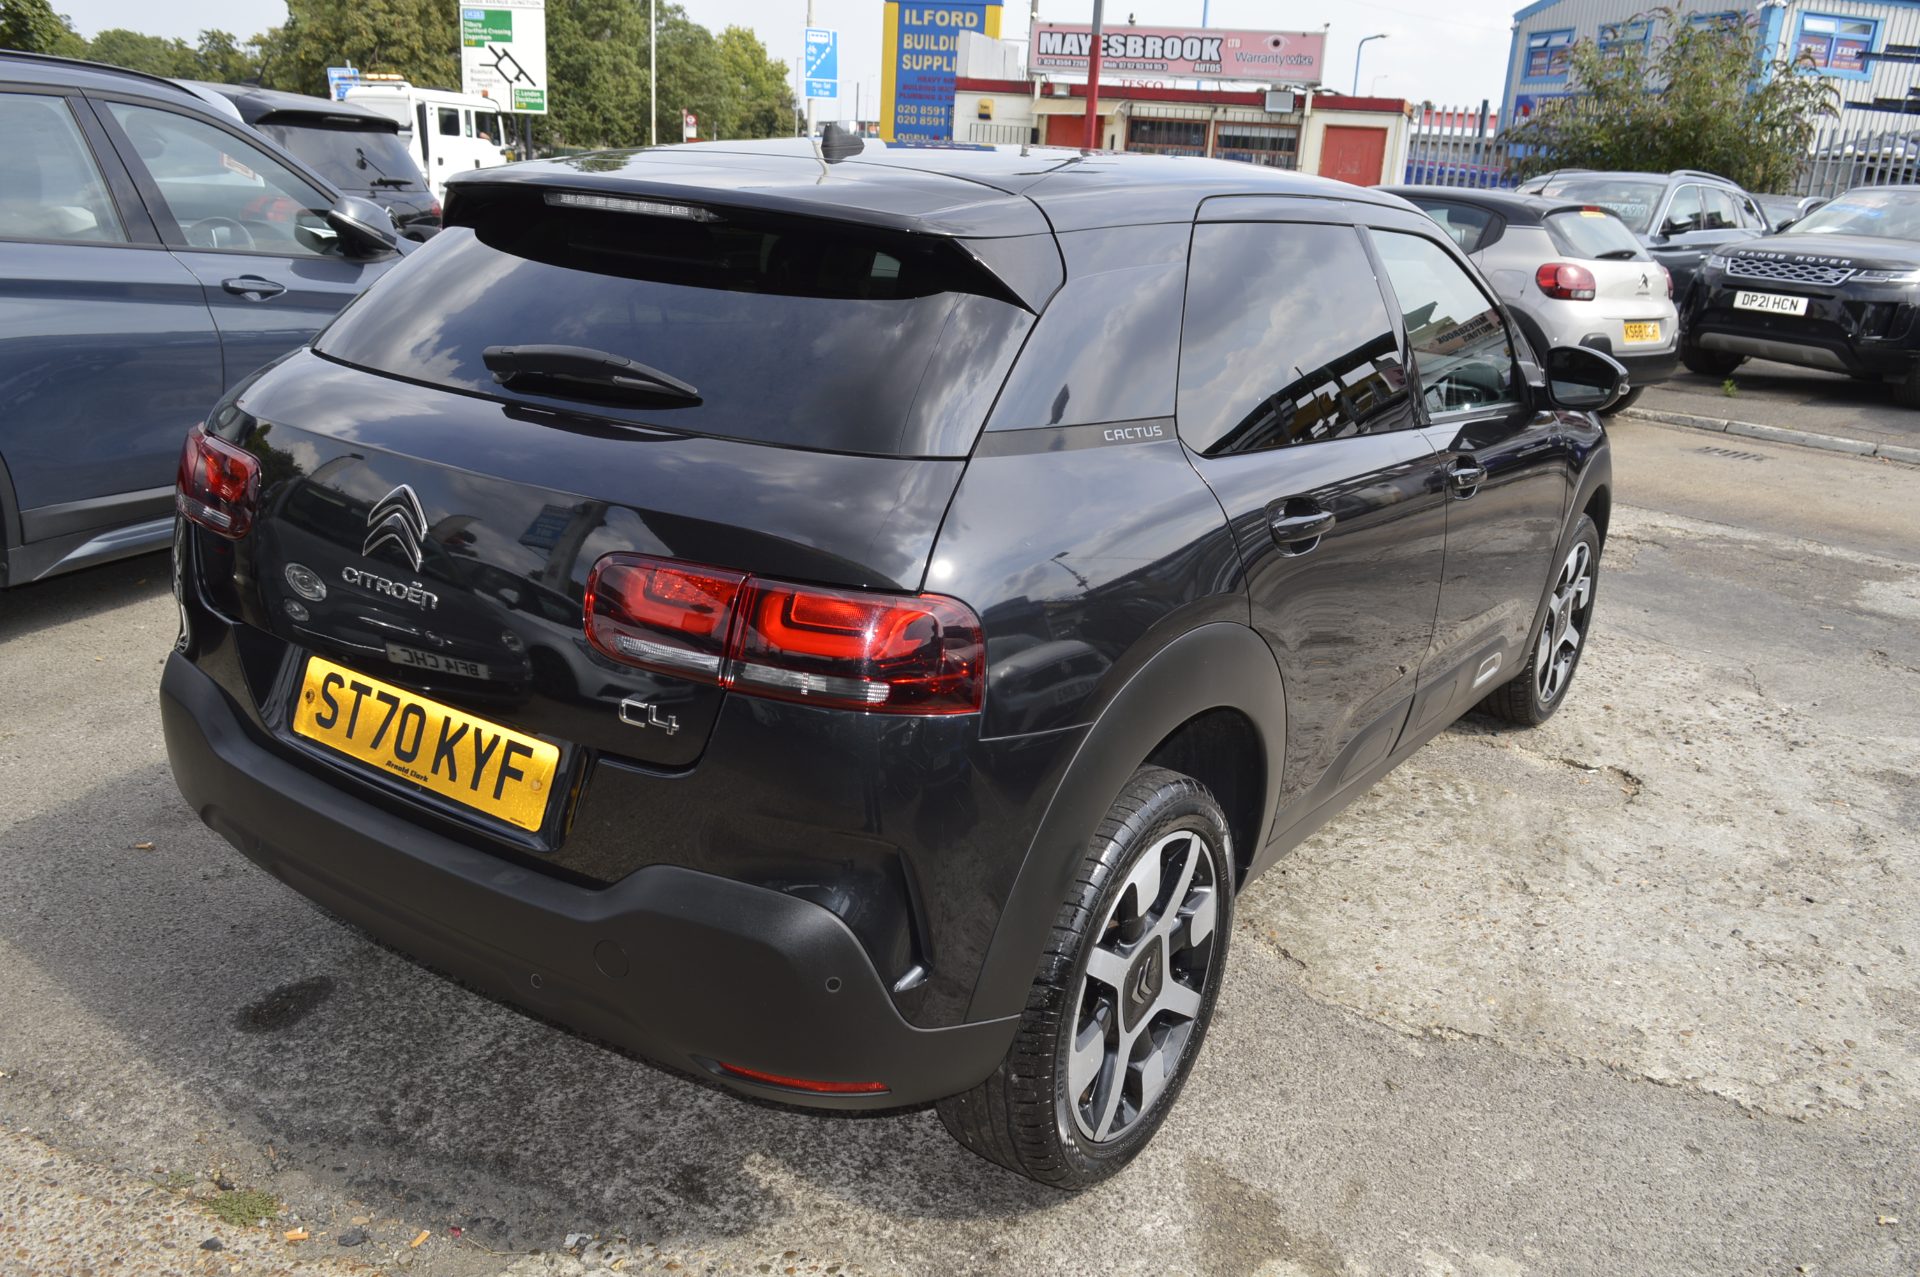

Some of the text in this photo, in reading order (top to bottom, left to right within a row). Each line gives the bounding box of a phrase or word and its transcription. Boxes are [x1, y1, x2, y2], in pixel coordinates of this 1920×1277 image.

[904, 9, 979, 28] ILFORD
[1038, 31, 1223, 62] MAYESBROOK
[1193, 62, 1222, 73] AUTOS
[1120, 79, 1164, 89] TESCO
[897, 104, 917, 114] 020
[920, 105, 945, 116] 8591
[897, 115, 917, 125] 020
[919, 116, 945, 127] 8591
[1738, 250, 1851, 266] RANGE ROVER
[1741, 293, 1799, 311] DP21 HCN
[1103, 425, 1163, 441] CACTUS
[619, 698, 679, 736] C4
[315, 672, 534, 801] ST70 KYF
[385, 760, 429, 783] Arnold Clark
